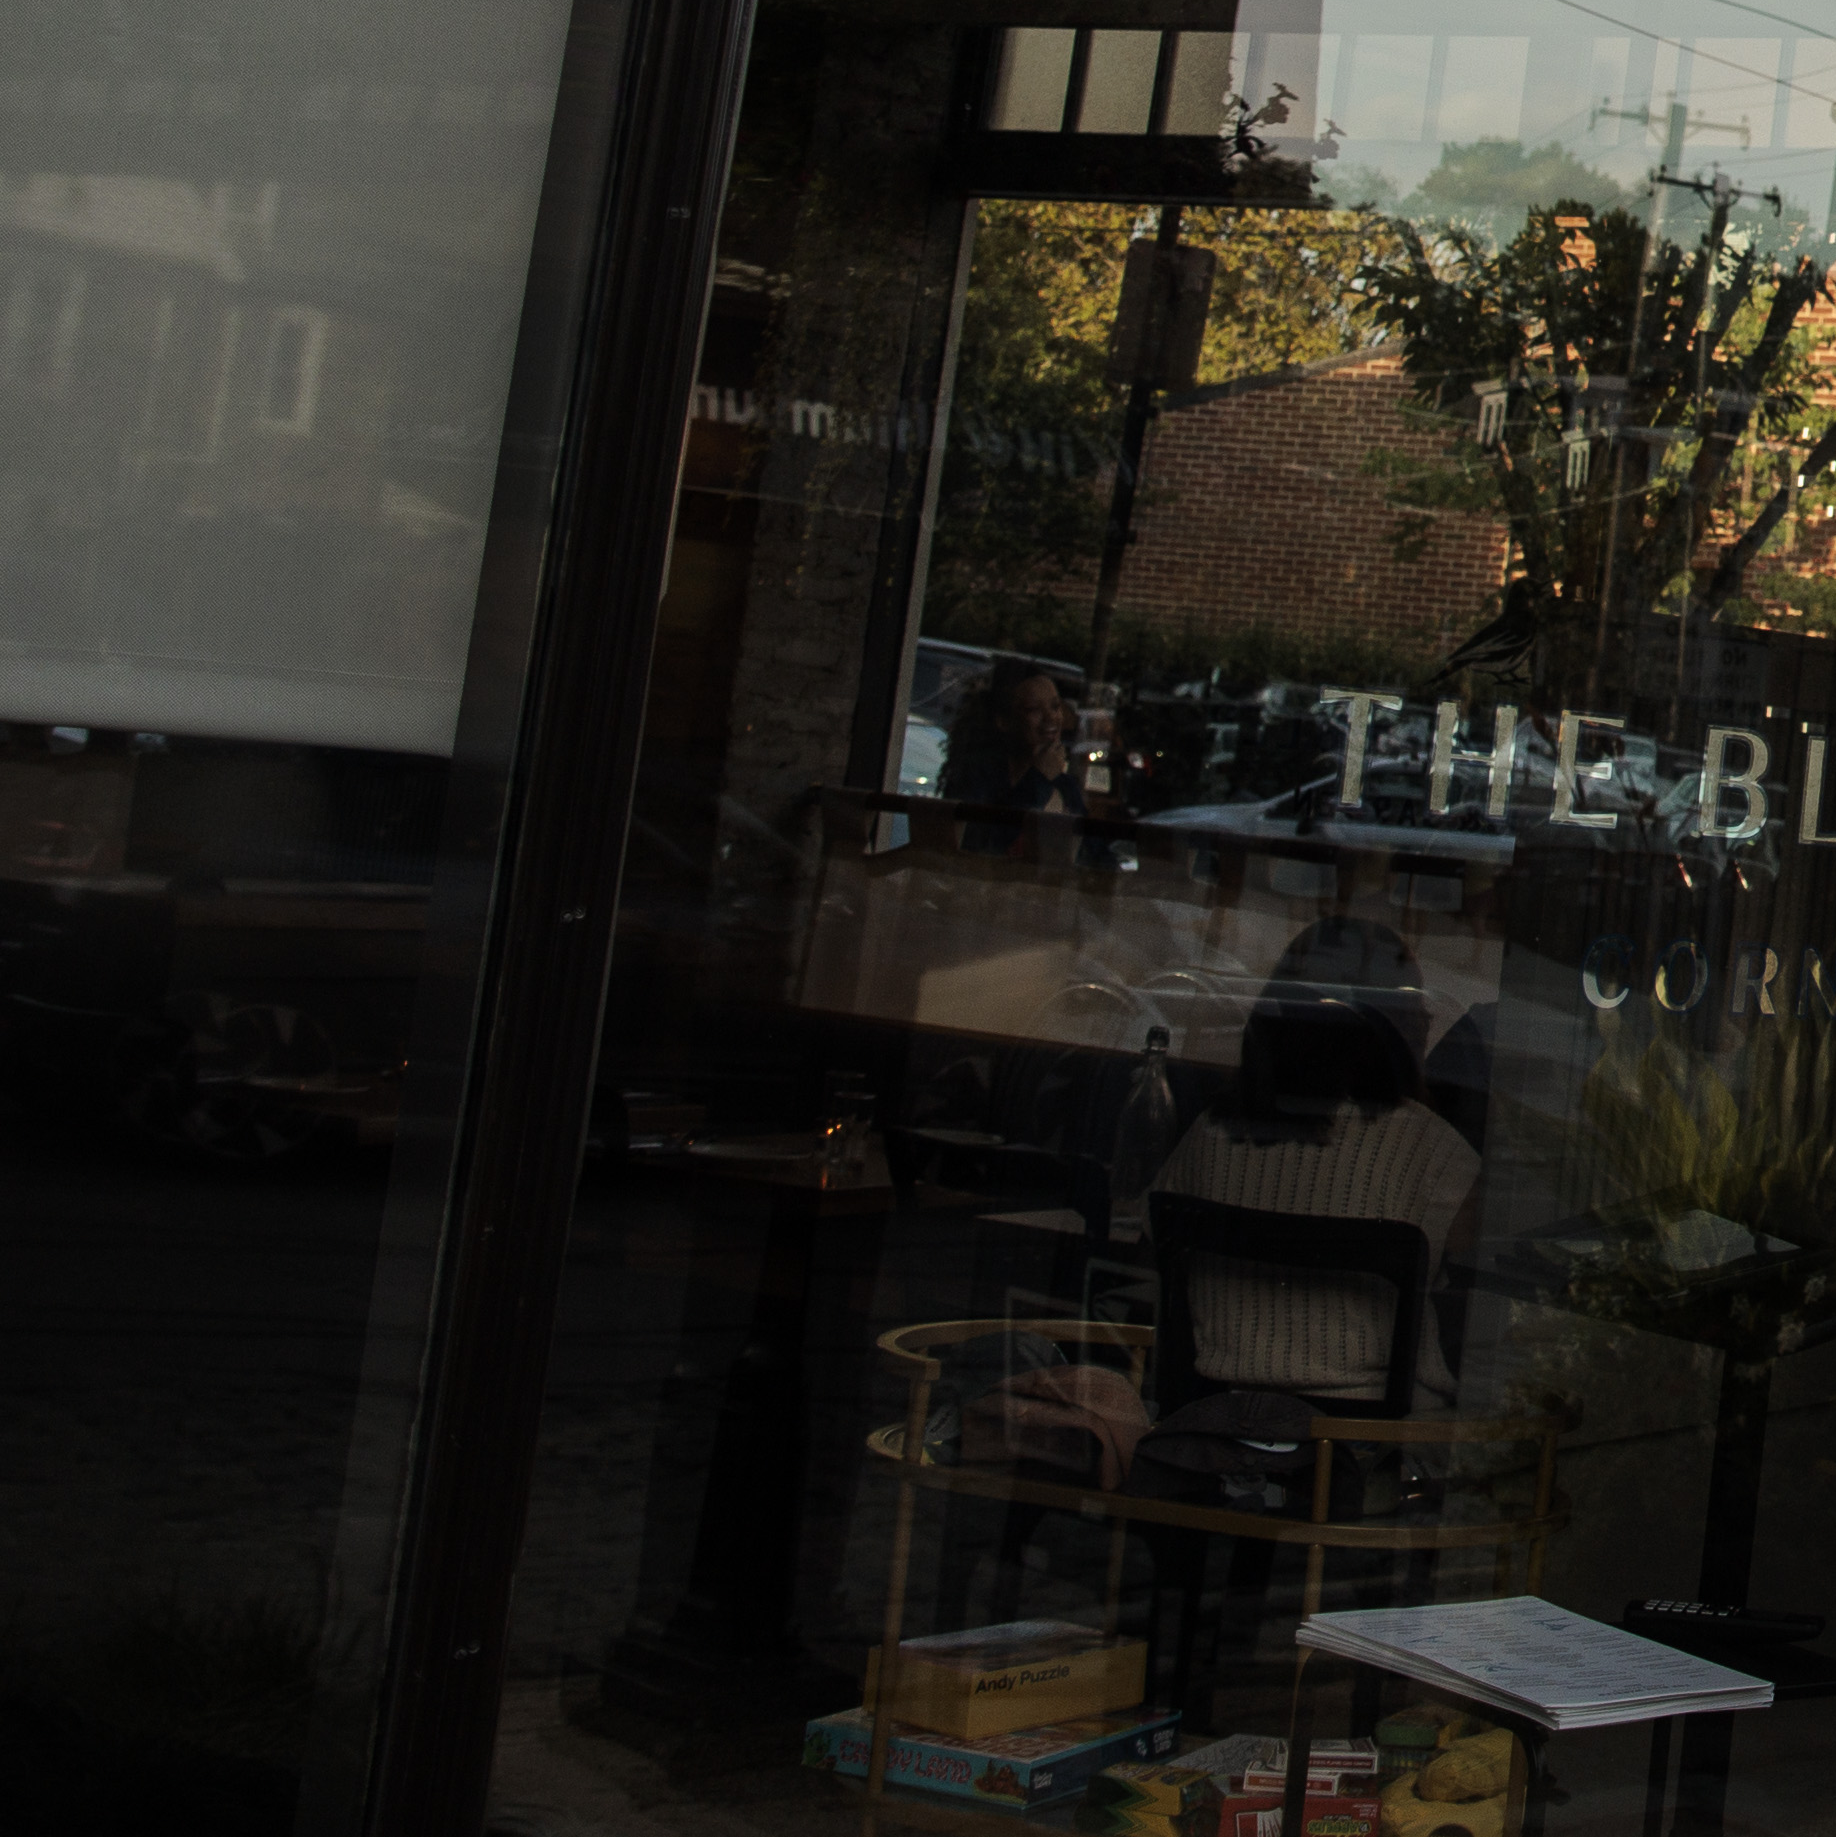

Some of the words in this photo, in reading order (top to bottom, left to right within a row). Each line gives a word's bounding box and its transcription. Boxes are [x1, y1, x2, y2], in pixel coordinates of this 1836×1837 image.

[1319, 686, 1626, 830] THE
[975, 1675, 1017, 1694] Andy
[1020, 1665, 1070, 1686] Puzzle
[839, 1739, 912, 1772] CADY
[914, 1751, 973, 1785] LAND
